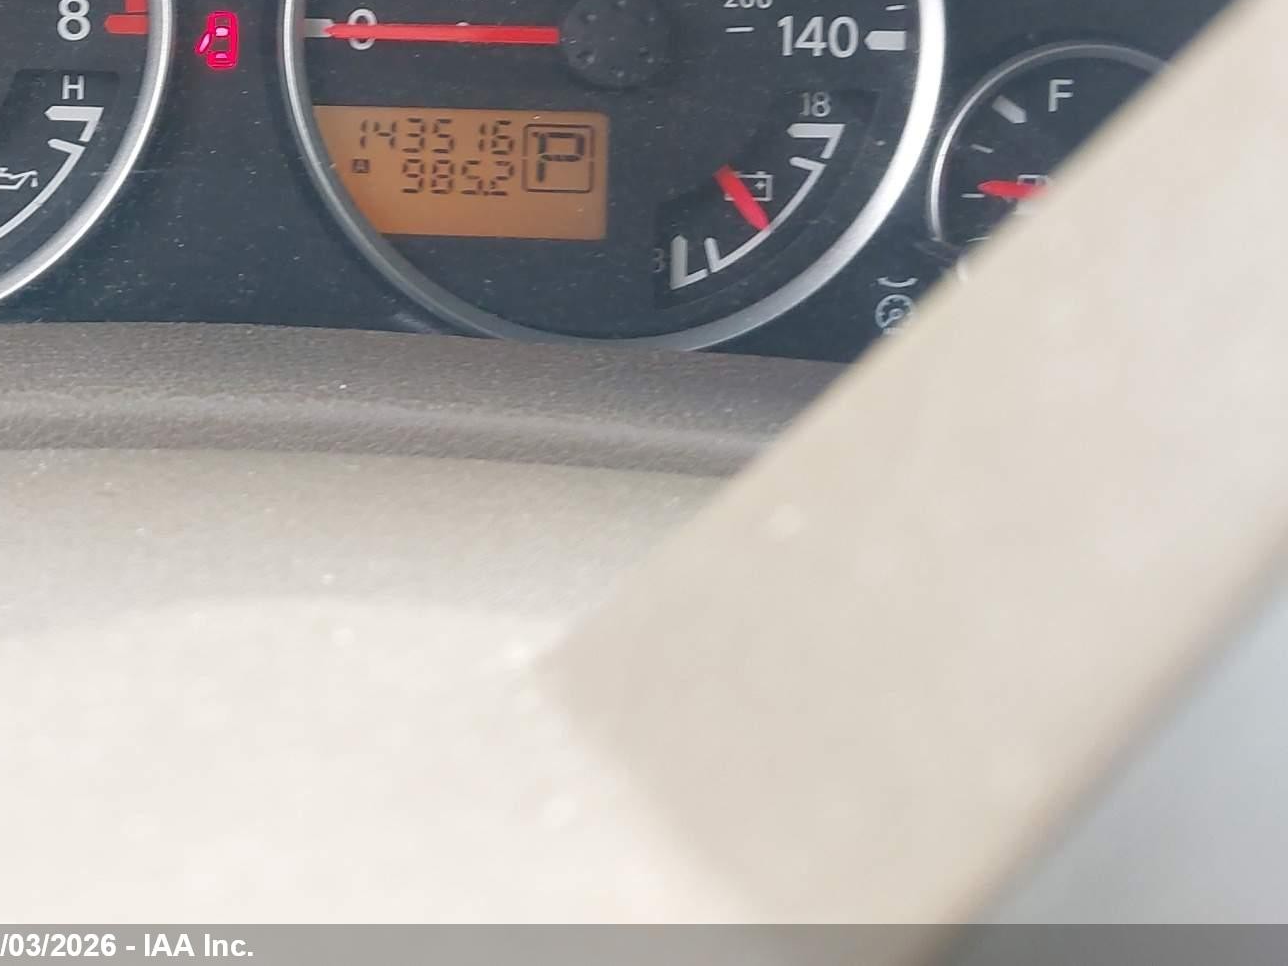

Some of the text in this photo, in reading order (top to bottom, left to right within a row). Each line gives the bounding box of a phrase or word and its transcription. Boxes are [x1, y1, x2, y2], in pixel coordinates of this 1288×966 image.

[348, 9, 376, 50] 0
[778, 16, 858, 58] 140
[62, 75, 84, 99] H
[802, 93, 831, 117] 18
[1048, 80, 1073, 112] F
[359, 118, 516, 156] 143516
[533, 130, 586, 184] P
